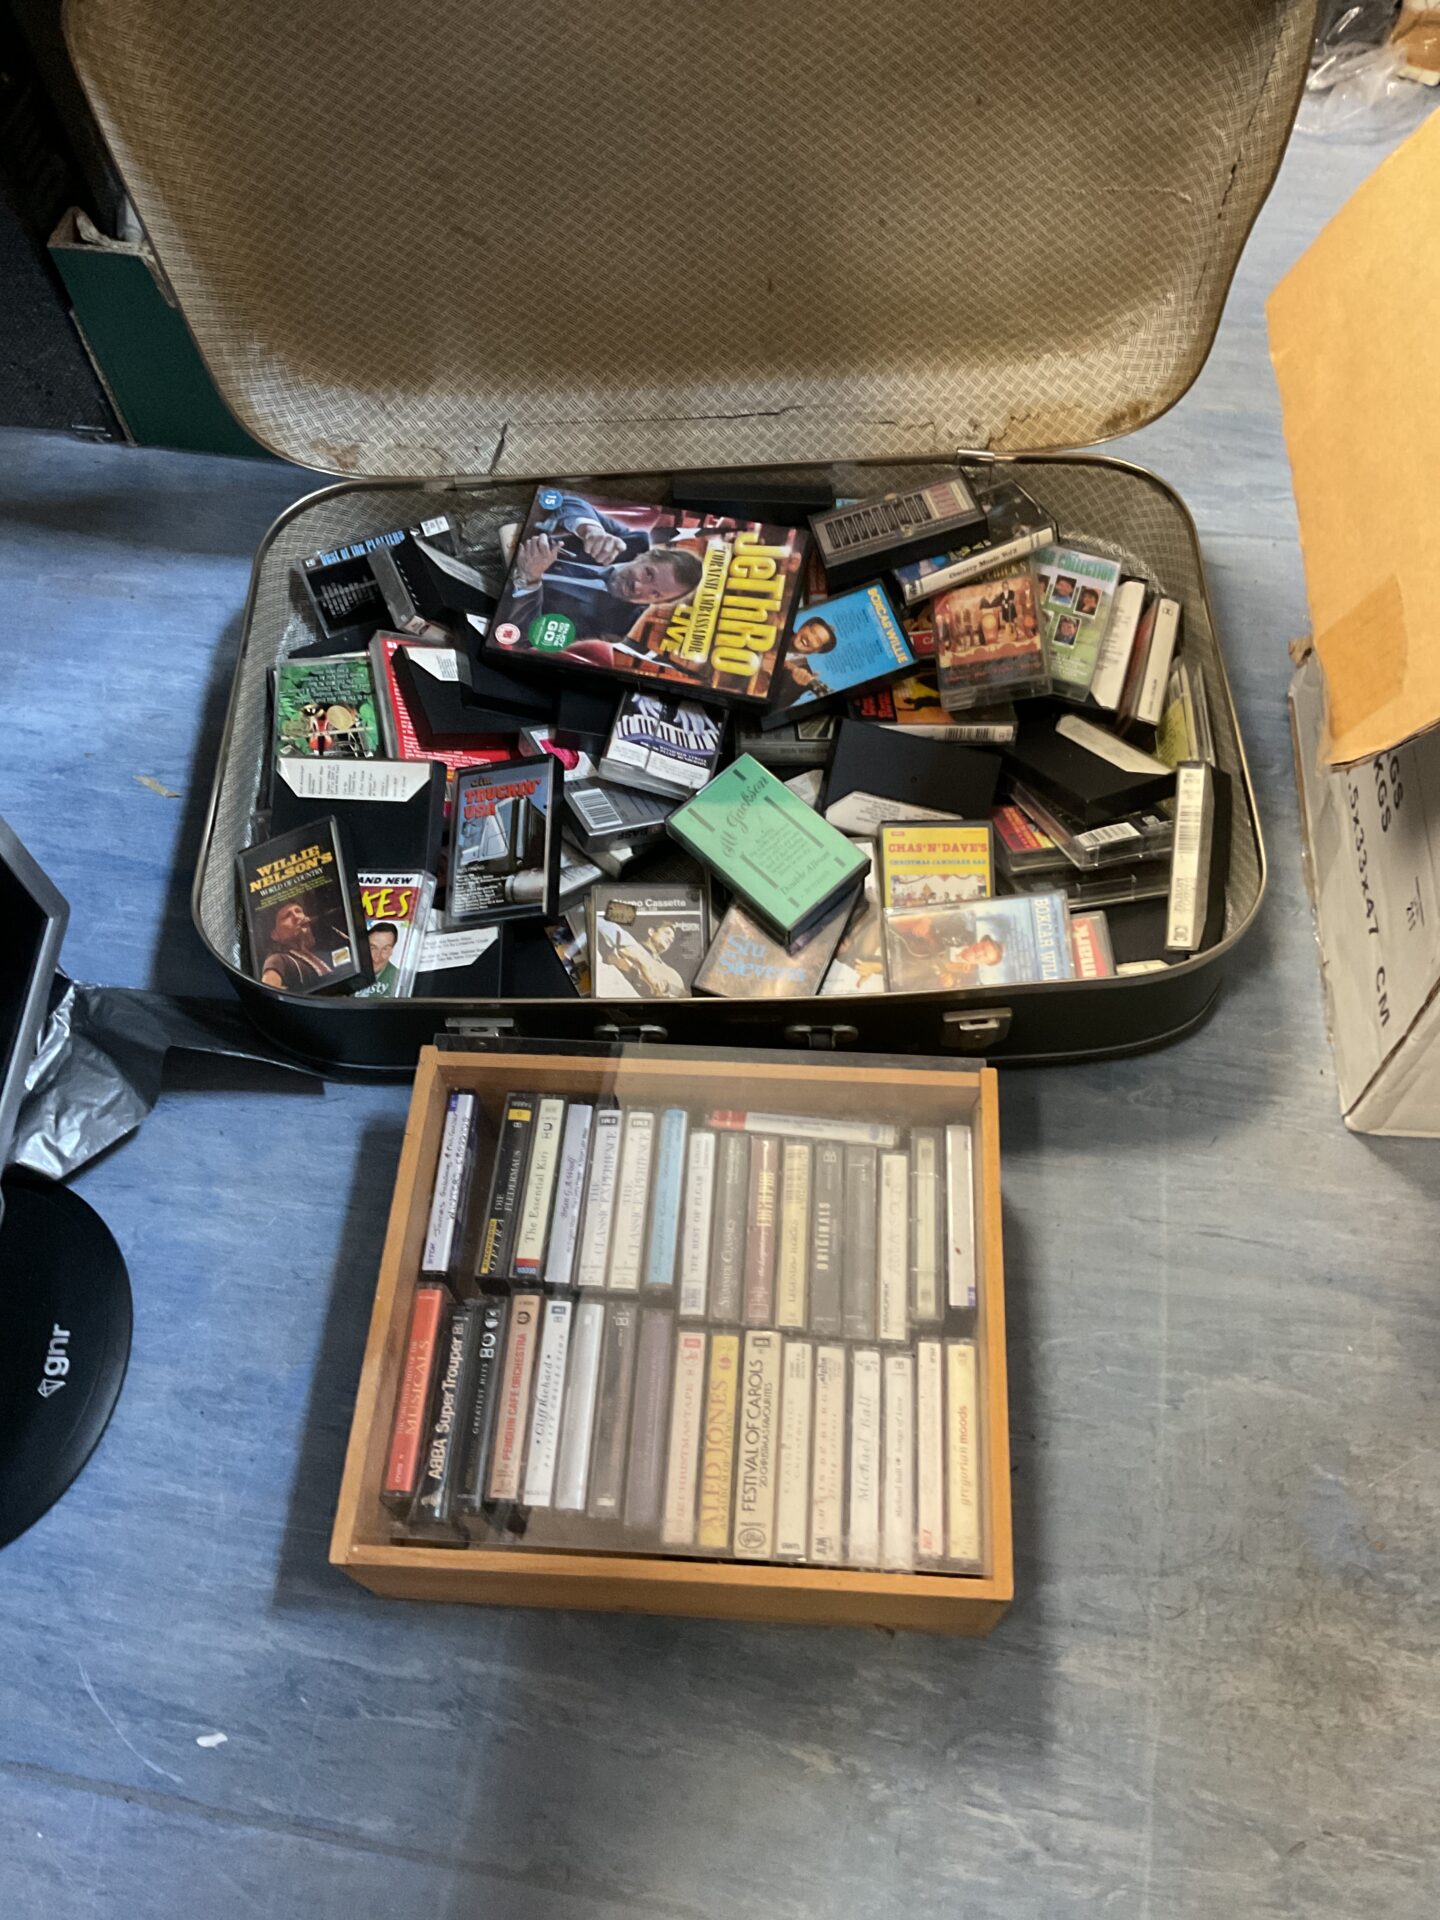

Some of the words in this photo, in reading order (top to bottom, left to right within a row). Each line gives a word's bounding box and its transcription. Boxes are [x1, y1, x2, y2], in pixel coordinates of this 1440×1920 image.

[545, 494, 557, 506] 15
[659, 603, 694, 654] LIVE
[464, 803, 497, 820] USA
[249, 851, 334, 893] NELSON'S
[256, 845, 320, 878] WILLIE
[385, 876, 413, 885] NEW
[362, 888, 412, 918] KES
[645, 899, 687, 908] Cassette
[1347, 768, 1380, 936] .5x33x47
[1375, 966, 1390, 1028] CM
[495, 1193, 505, 1212] DIE
[505, 1150, 523, 1213] FLEDERMAUS
[529, 1171, 546, 1216] Essential
[526, 1218, 537, 1243] The
[595, 1210, 609, 1255] CLASSIC
[628, 1210, 642, 1257] CLASSIC
[693, 1226, 701, 1251] BEST
[694, 1209, 703, 1223] OF
[816, 1201, 832, 1271] ORIGINALS
[488, 1218, 505, 1273] OPERA
[691, 1255, 699, 1274] THE
[405, 1339, 431, 1435] MUSICALS
[502, 1416, 518, 1461] PENGUIN
[511, 1332, 527, 1389] ORCHESTRA
[747, 1359, 764, 1419] CAROLS
[761, 1382, 773, 1429] FAVOURITES
[472, 1388, 486, 1435] GREATEST
[706, 1380, 729, 1457] JONES
[744, 1422, 760, 1444] OF
[858, 1394, 873, 1428] Ball
[955, 1404, 968, 1444] moods
[427, 1438, 447, 1480] ABBA
[759, 1429, 771, 1475] CHRISTMAS
[855, 1439, 872, 1502] Michael
[700, 1461, 723, 1532] ALED
[741, 1447, 760, 1512] FESTIVAL
[758, 1475, 768, 1488] 20
[955, 1446, 972, 1508] gregorian
